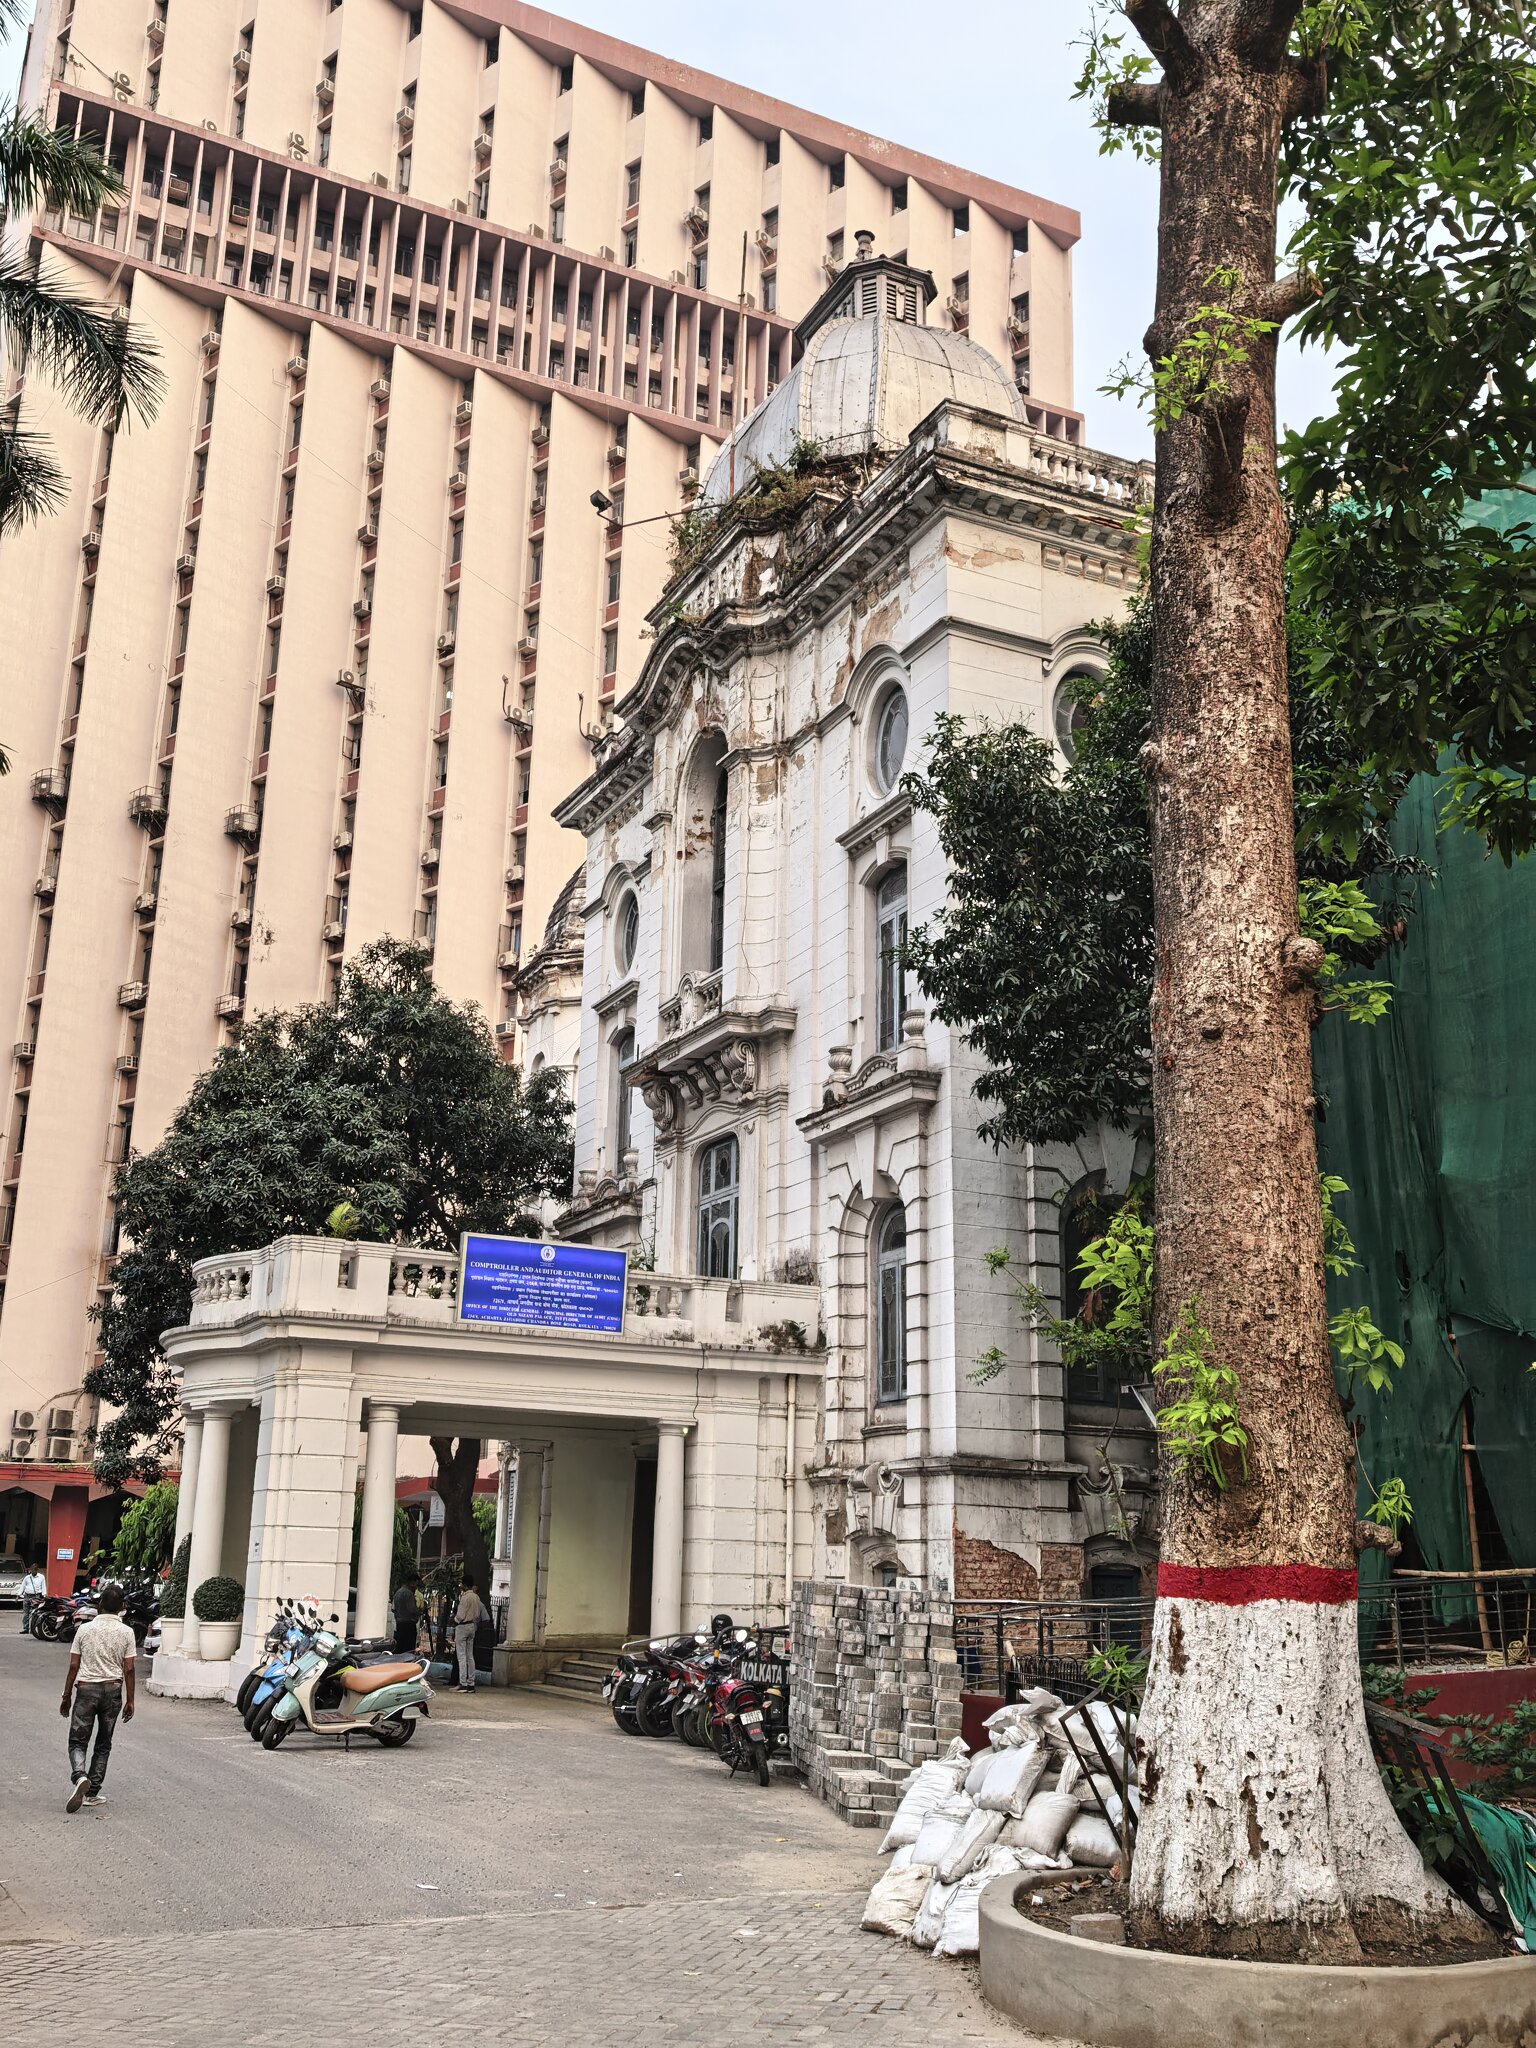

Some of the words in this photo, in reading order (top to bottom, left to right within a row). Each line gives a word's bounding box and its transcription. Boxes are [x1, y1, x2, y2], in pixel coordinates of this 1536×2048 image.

[470, 1261, 519, 1271] COMPTROLLER
[534, 1268, 563, 1276] AUDITOR
[563, 1270, 592, 1278] GENERAL
[741, 1661, 782, 1684] KOLKATA
